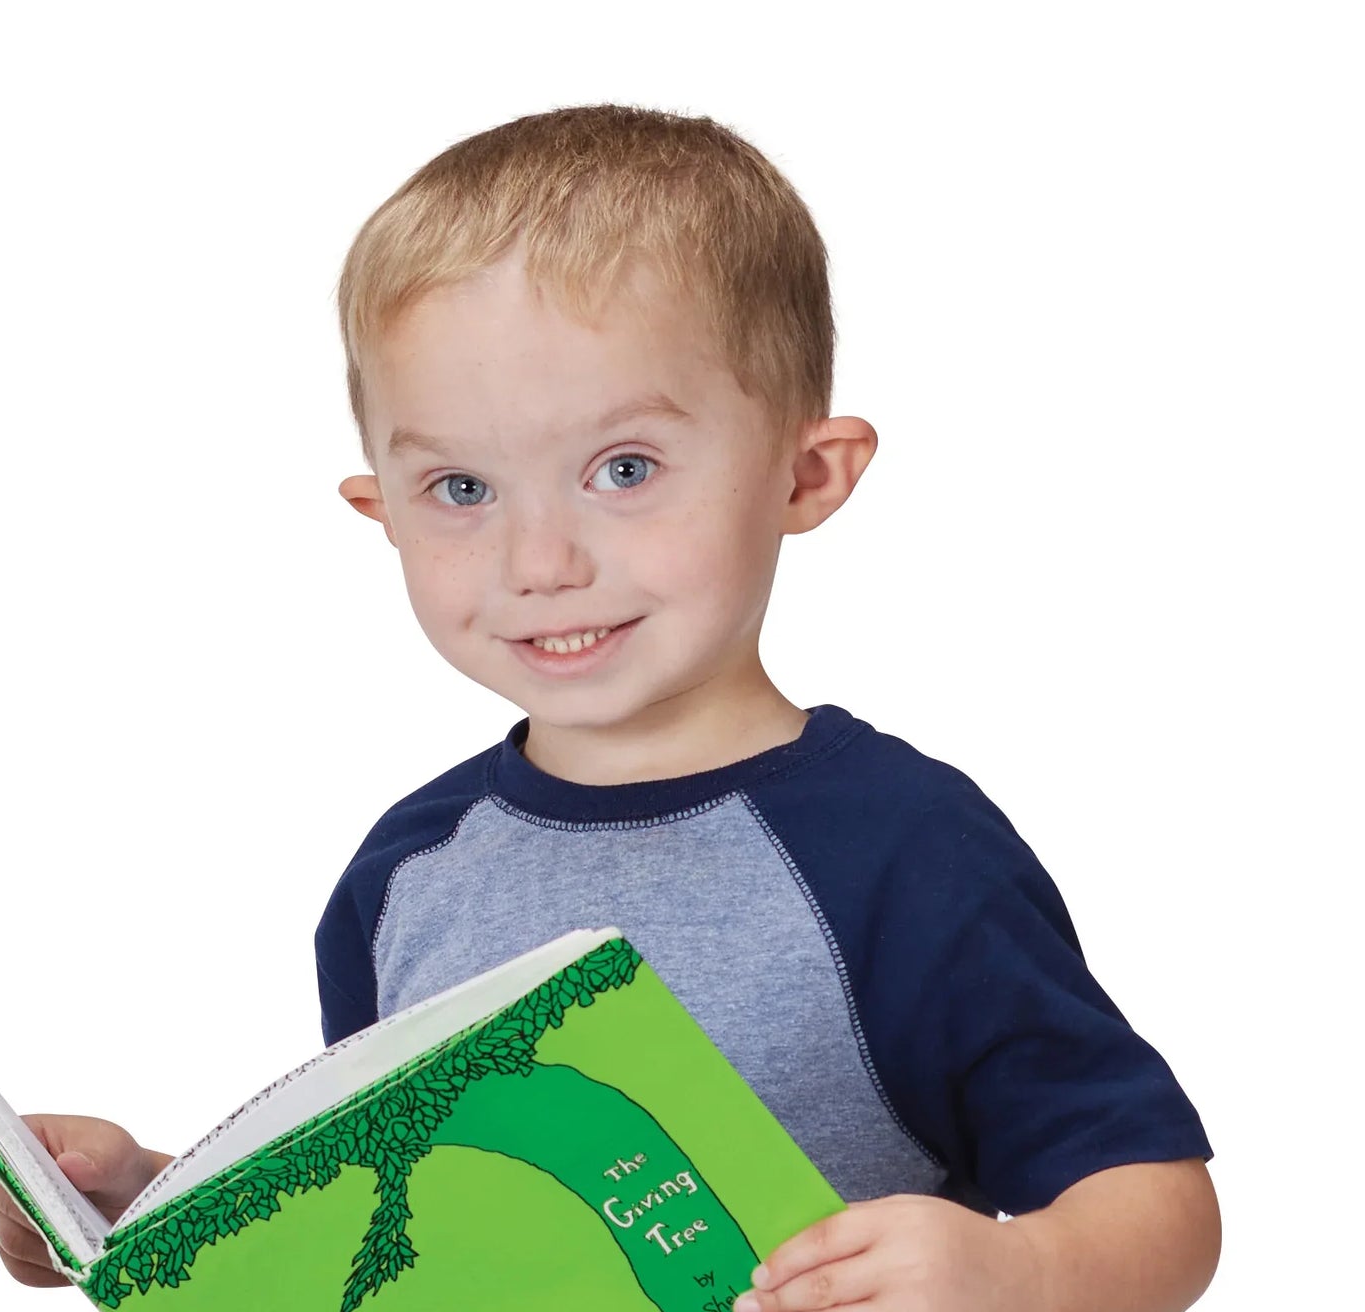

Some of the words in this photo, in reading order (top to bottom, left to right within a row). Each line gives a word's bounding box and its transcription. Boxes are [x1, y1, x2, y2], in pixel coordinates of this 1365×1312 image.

[603, 1152, 648, 1183] The
[602, 1170, 698, 1229] Giving
[644, 1218, 709, 1256] Tree
[693, 1270, 714, 1287] by
